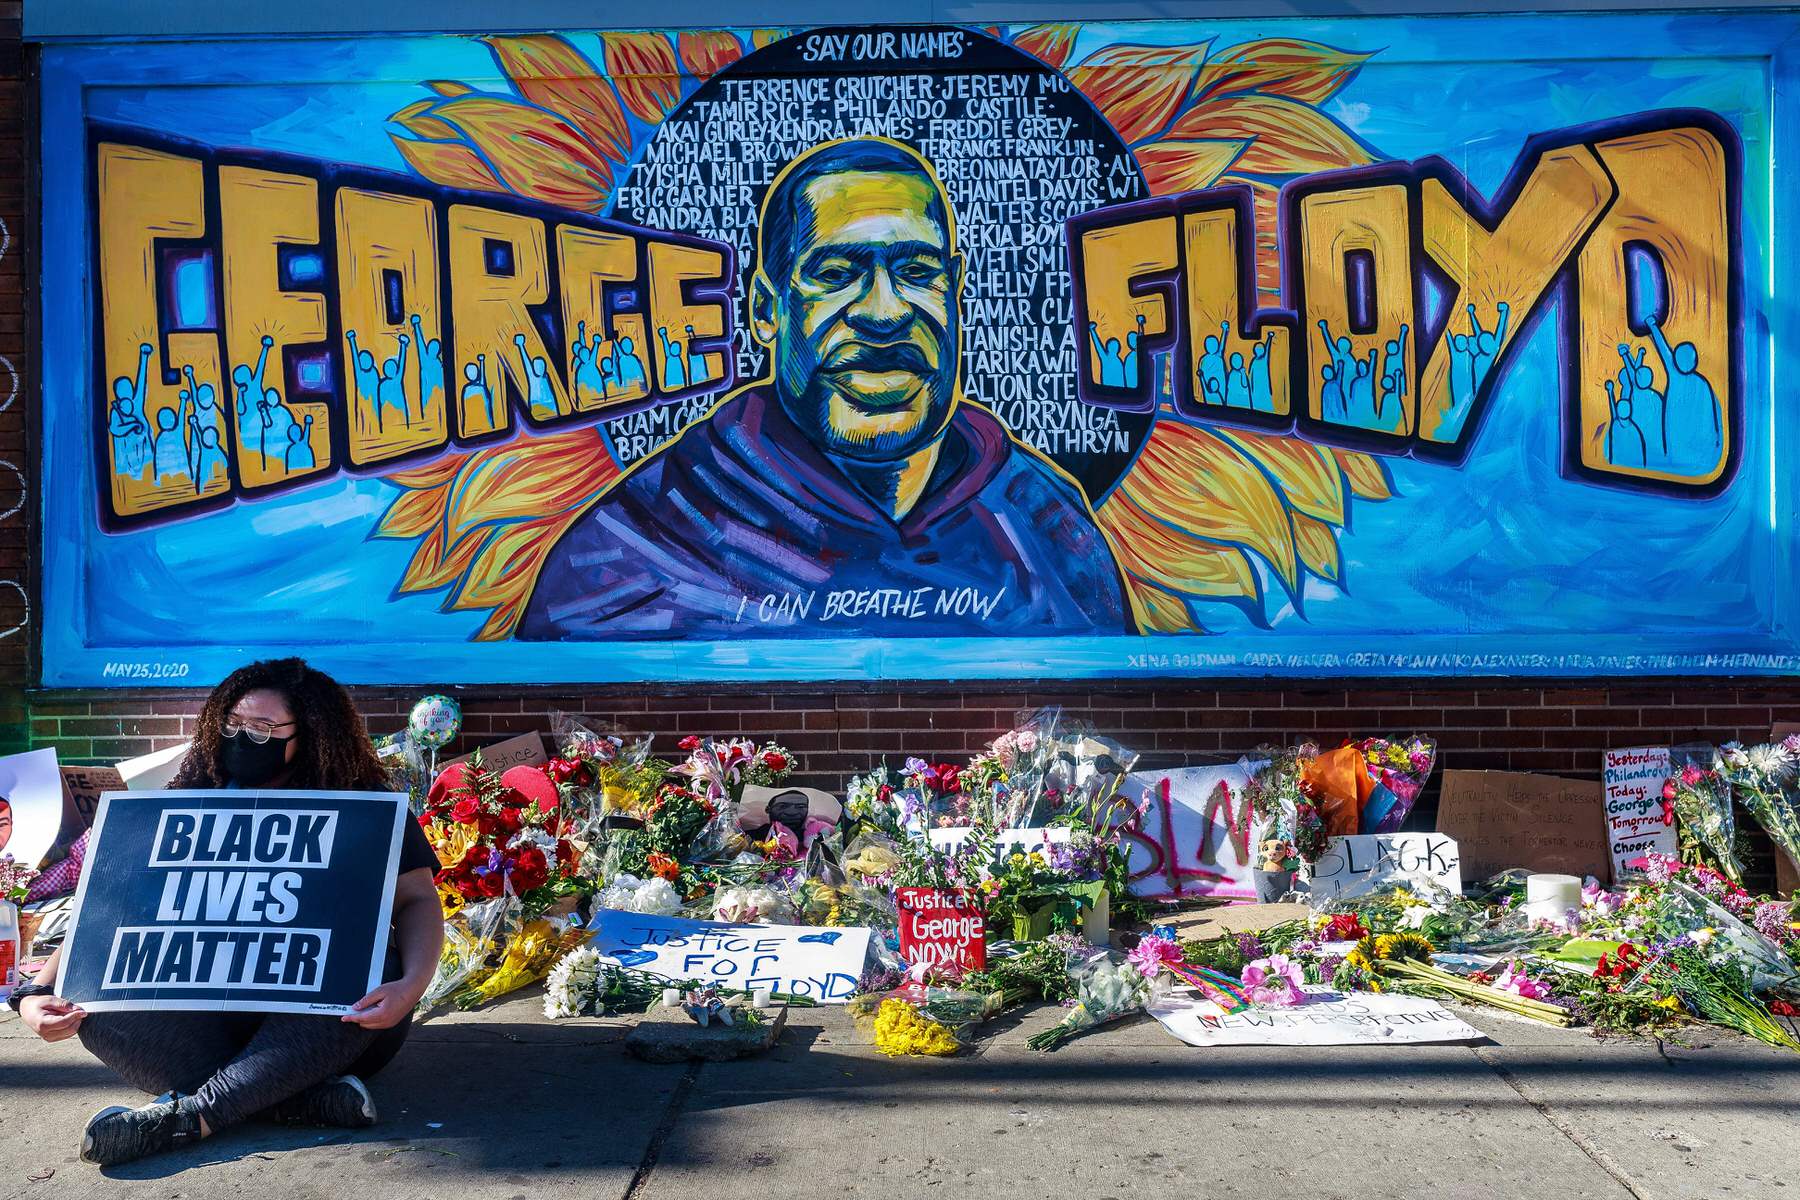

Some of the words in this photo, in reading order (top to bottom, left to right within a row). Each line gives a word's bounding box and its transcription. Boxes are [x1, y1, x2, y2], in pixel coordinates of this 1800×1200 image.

[803, 35, 849, 61] SAY
[853, 33, 898, 60] OUR
[901, 31, 964, 58] NAMES
[720, 79, 830, 102] TERRENCE
[835, 75, 936, 100] CRUTCHER
[942, 74, 1030, 99] JEREMY
[694, 101, 760, 122] TAMIR
[762, 101, 815, 121] RICE
[834, 98, 946, 119] PHILANDO
[966, 97, 1048, 119] CASTILE
[656, 121, 699, 143] AKAI
[704, 121, 768, 143] GURLEY
[770, 119, 845, 142] KENDRA
[848, 117, 914, 140] JAMES
[929, 119, 1014, 139] FREDDIE
[1018, 117, 1072, 140] GREY
[647, 142, 736, 165] MICHAEL
[916, 138, 1001, 158] TERRANCE
[1005, 138, 1093, 157] FRANKLIN
[632, 163, 703, 188] TYISHA
[711, 162, 776, 186] MILLE
[935, 158, 1025, 180] BREONNA
[1025, 156, 1102, 179] TAYLOR
[617, 186, 664, 209] ERIC
[666, 185, 757, 208] GARNER
[946, 179, 1037, 202] SHANTEL
[1040, 178, 1098, 201] DAVIS
[632, 207, 717, 230] SANDRA
[722, 204, 760, 228] BLA
[952, 200, 1037, 226] WALTER
[956, 225, 1019, 247] REKIA
[1024, 246, 1064, 272] SMI
[962, 271, 1038, 298] SHELLY
[960, 298, 1036, 327] JAMAR
[1078, 125, 1730, 485] FLOYD
[92, 142, 726, 518] GEORGE
[962, 326, 1055, 351] TANISHA
[962, 350, 1042, 374] TARIKA
[964, 374, 1032, 401] ALTON
[1036, 373, 1076, 400] STE
[1021, 430, 1130, 455] KATHRYN
[758, 590, 816, 622] CAN
[819, 586, 934, 621] BREATHE
[934, 586, 1007, 621] NOW
[482, 746, 538, 771] ustice
[1607, 749, 1668, 767] Yesterday:
[1608, 784, 1647, 800] Today:
[1608, 797, 1654, 815] George
[156, 813, 331, 863] BLACK
[156, 871, 302, 923] LIVES
[903, 890, 965, 909] Justice
[912, 911, 984, 947] George
[110, 931, 322, 986] MATTER
[1197, 1013, 1274, 1029] NEW
